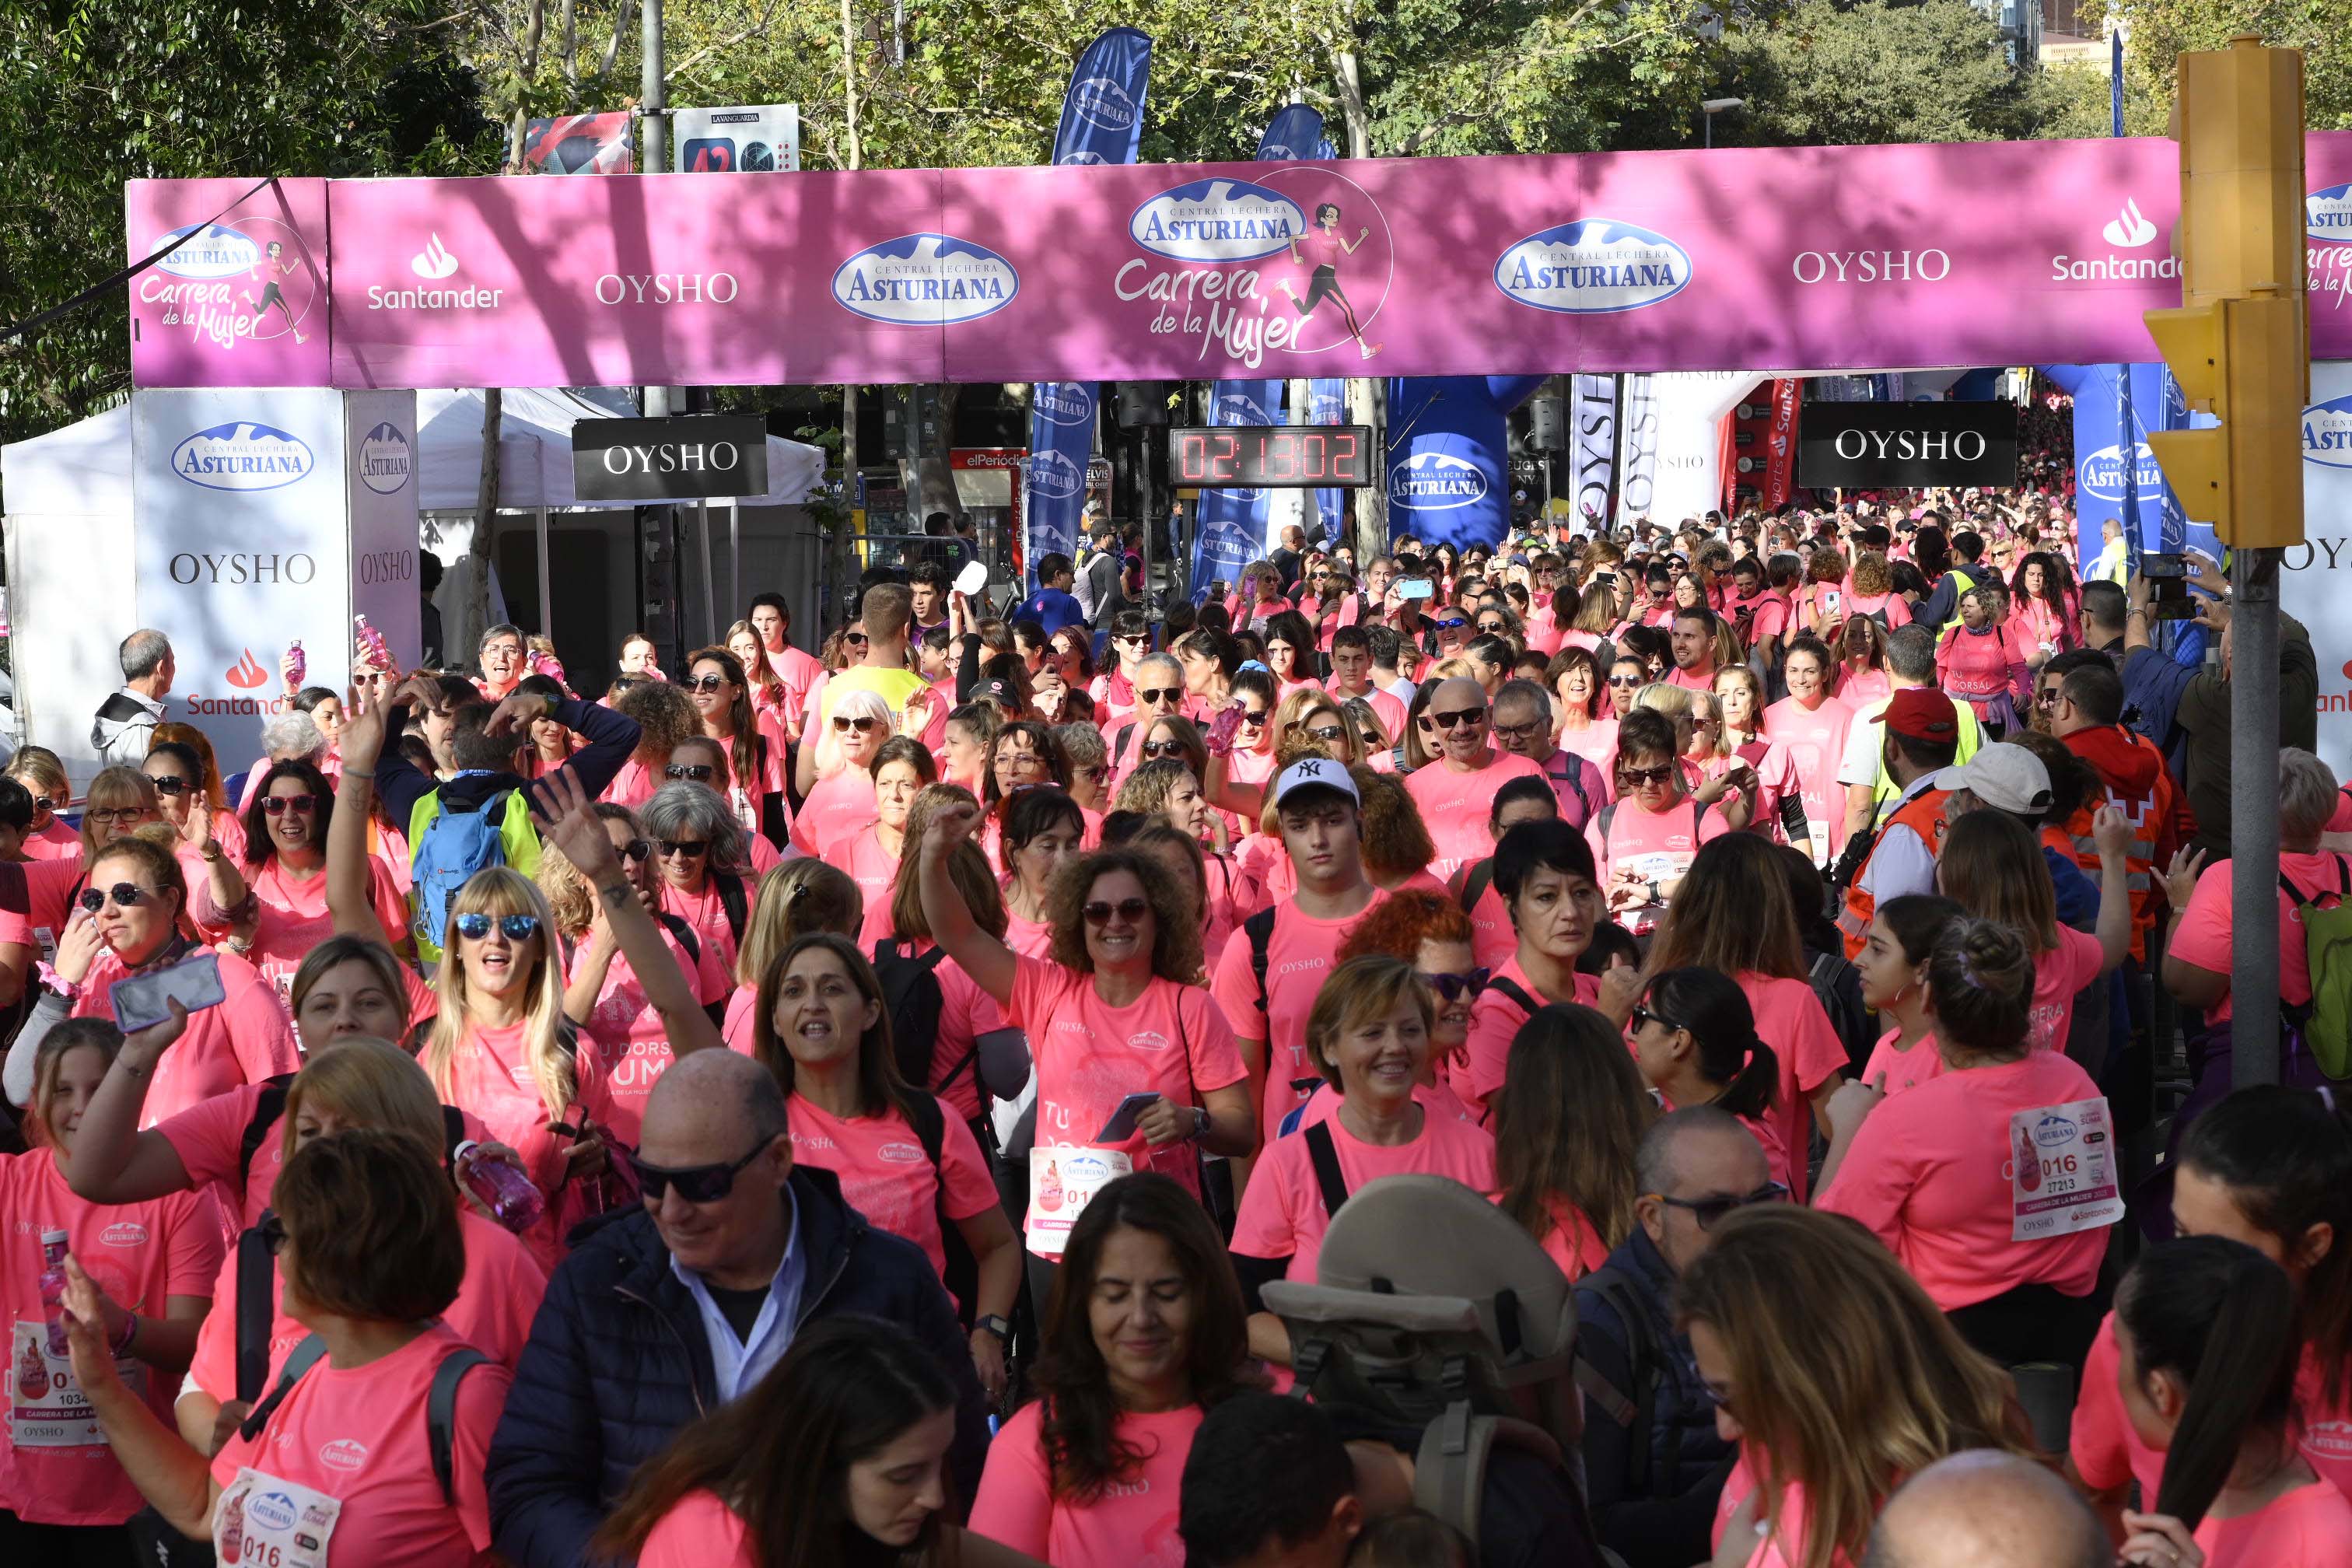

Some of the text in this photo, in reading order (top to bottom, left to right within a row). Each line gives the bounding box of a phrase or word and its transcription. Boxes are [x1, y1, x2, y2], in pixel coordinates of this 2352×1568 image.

[1170, 206, 1287, 216] CENTRAL LECHERA
[1143, 210, 1292, 241] ASTURIANA
[1540, 250, 1669, 261] CENTRAL LECHERA
[1793, 248, 1950, 283] OYSHO
[875, 264, 997, 275] CENTRAL LECHERA
[1115, 258, 1259, 302] Carrera
[1509, 255, 1676, 289] ASTURIANA
[2324, 268, 2339, 291] la
[139, 275, 232, 304] Carrera
[368, 284, 503, 310] Santander
[594, 272, 739, 304] OYSHO
[845, 268, 1005, 301] ASTURIANA
[162, 302, 266, 348] de la Mujer
[1150, 296, 1314, 369] de la Mujer
[604, 441, 739, 474] OYSHO
[1835, 429, 1986, 461] OYSHO
[183, 447, 303, 474] ASTURIANA
[362, 449, 408, 477] ASTURIANA
[1392, 480, 1480, 498] ASTURIANA
[169, 553, 317, 585] OYSHO
[361, 549, 412, 585] OYSHO
[1435, 798, 1466, 812] OYSHO
[1279, 957, 1325, 974] OYSHO
[1055, 1020, 1096, 1039] OYSHO
[1129, 1037, 1168, 1048] ASTURIANA
[1045, 1101, 1070, 1129] TU
[2038, 1127, 2076, 1141] ASTURIANA
[1066, 1167, 1107, 1178] ASTURIANA
[2042, 1154, 2077, 1177] 016
[2047, 1178, 2075, 1193] 27213
[2026, 1201, 2053, 1211] CARRERA
[2070, 1194, 2090, 1205] MUJER
[2024, 1217, 2054, 1231] OYSHO
[26, 1409, 61, 1419] CARRERA
[63, 1409, 75, 1418] DE
[76, 1409, 86, 1418] LA
[23, 1426, 64, 1438] OYSHO
[244, 1536, 282, 1568] 016
